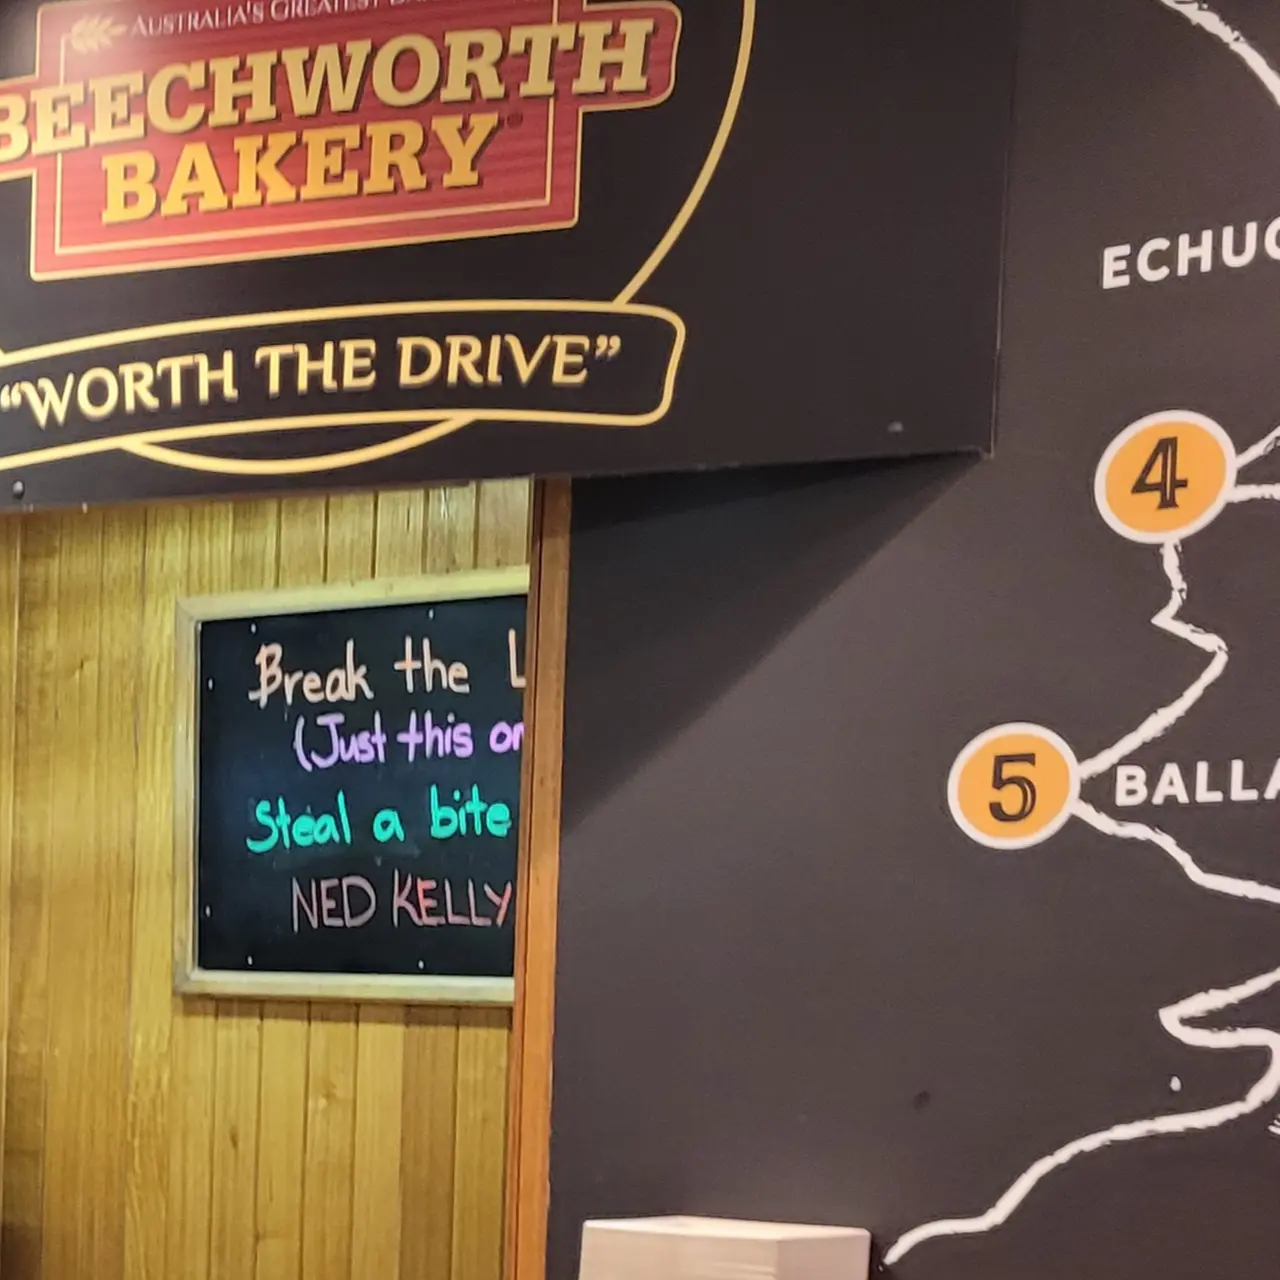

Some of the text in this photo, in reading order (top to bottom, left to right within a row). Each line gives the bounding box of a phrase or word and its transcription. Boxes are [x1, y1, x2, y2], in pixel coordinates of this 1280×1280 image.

[100, 112, 500, 227] BAKERY
[0, 333, 622, 429] “WORTH THE DRIVE”
[1131, 436, 1189, 511] 4
[248, 638, 374, 708] Break
[393, 635, 471, 694] the
[294, 710, 389, 772] (Just
[396, 709, 474, 762] this
[246, 783, 512, 854] Steal a bite
[989, 751, 1037, 823] 5
[292, 868, 513, 933] NED KELLY
